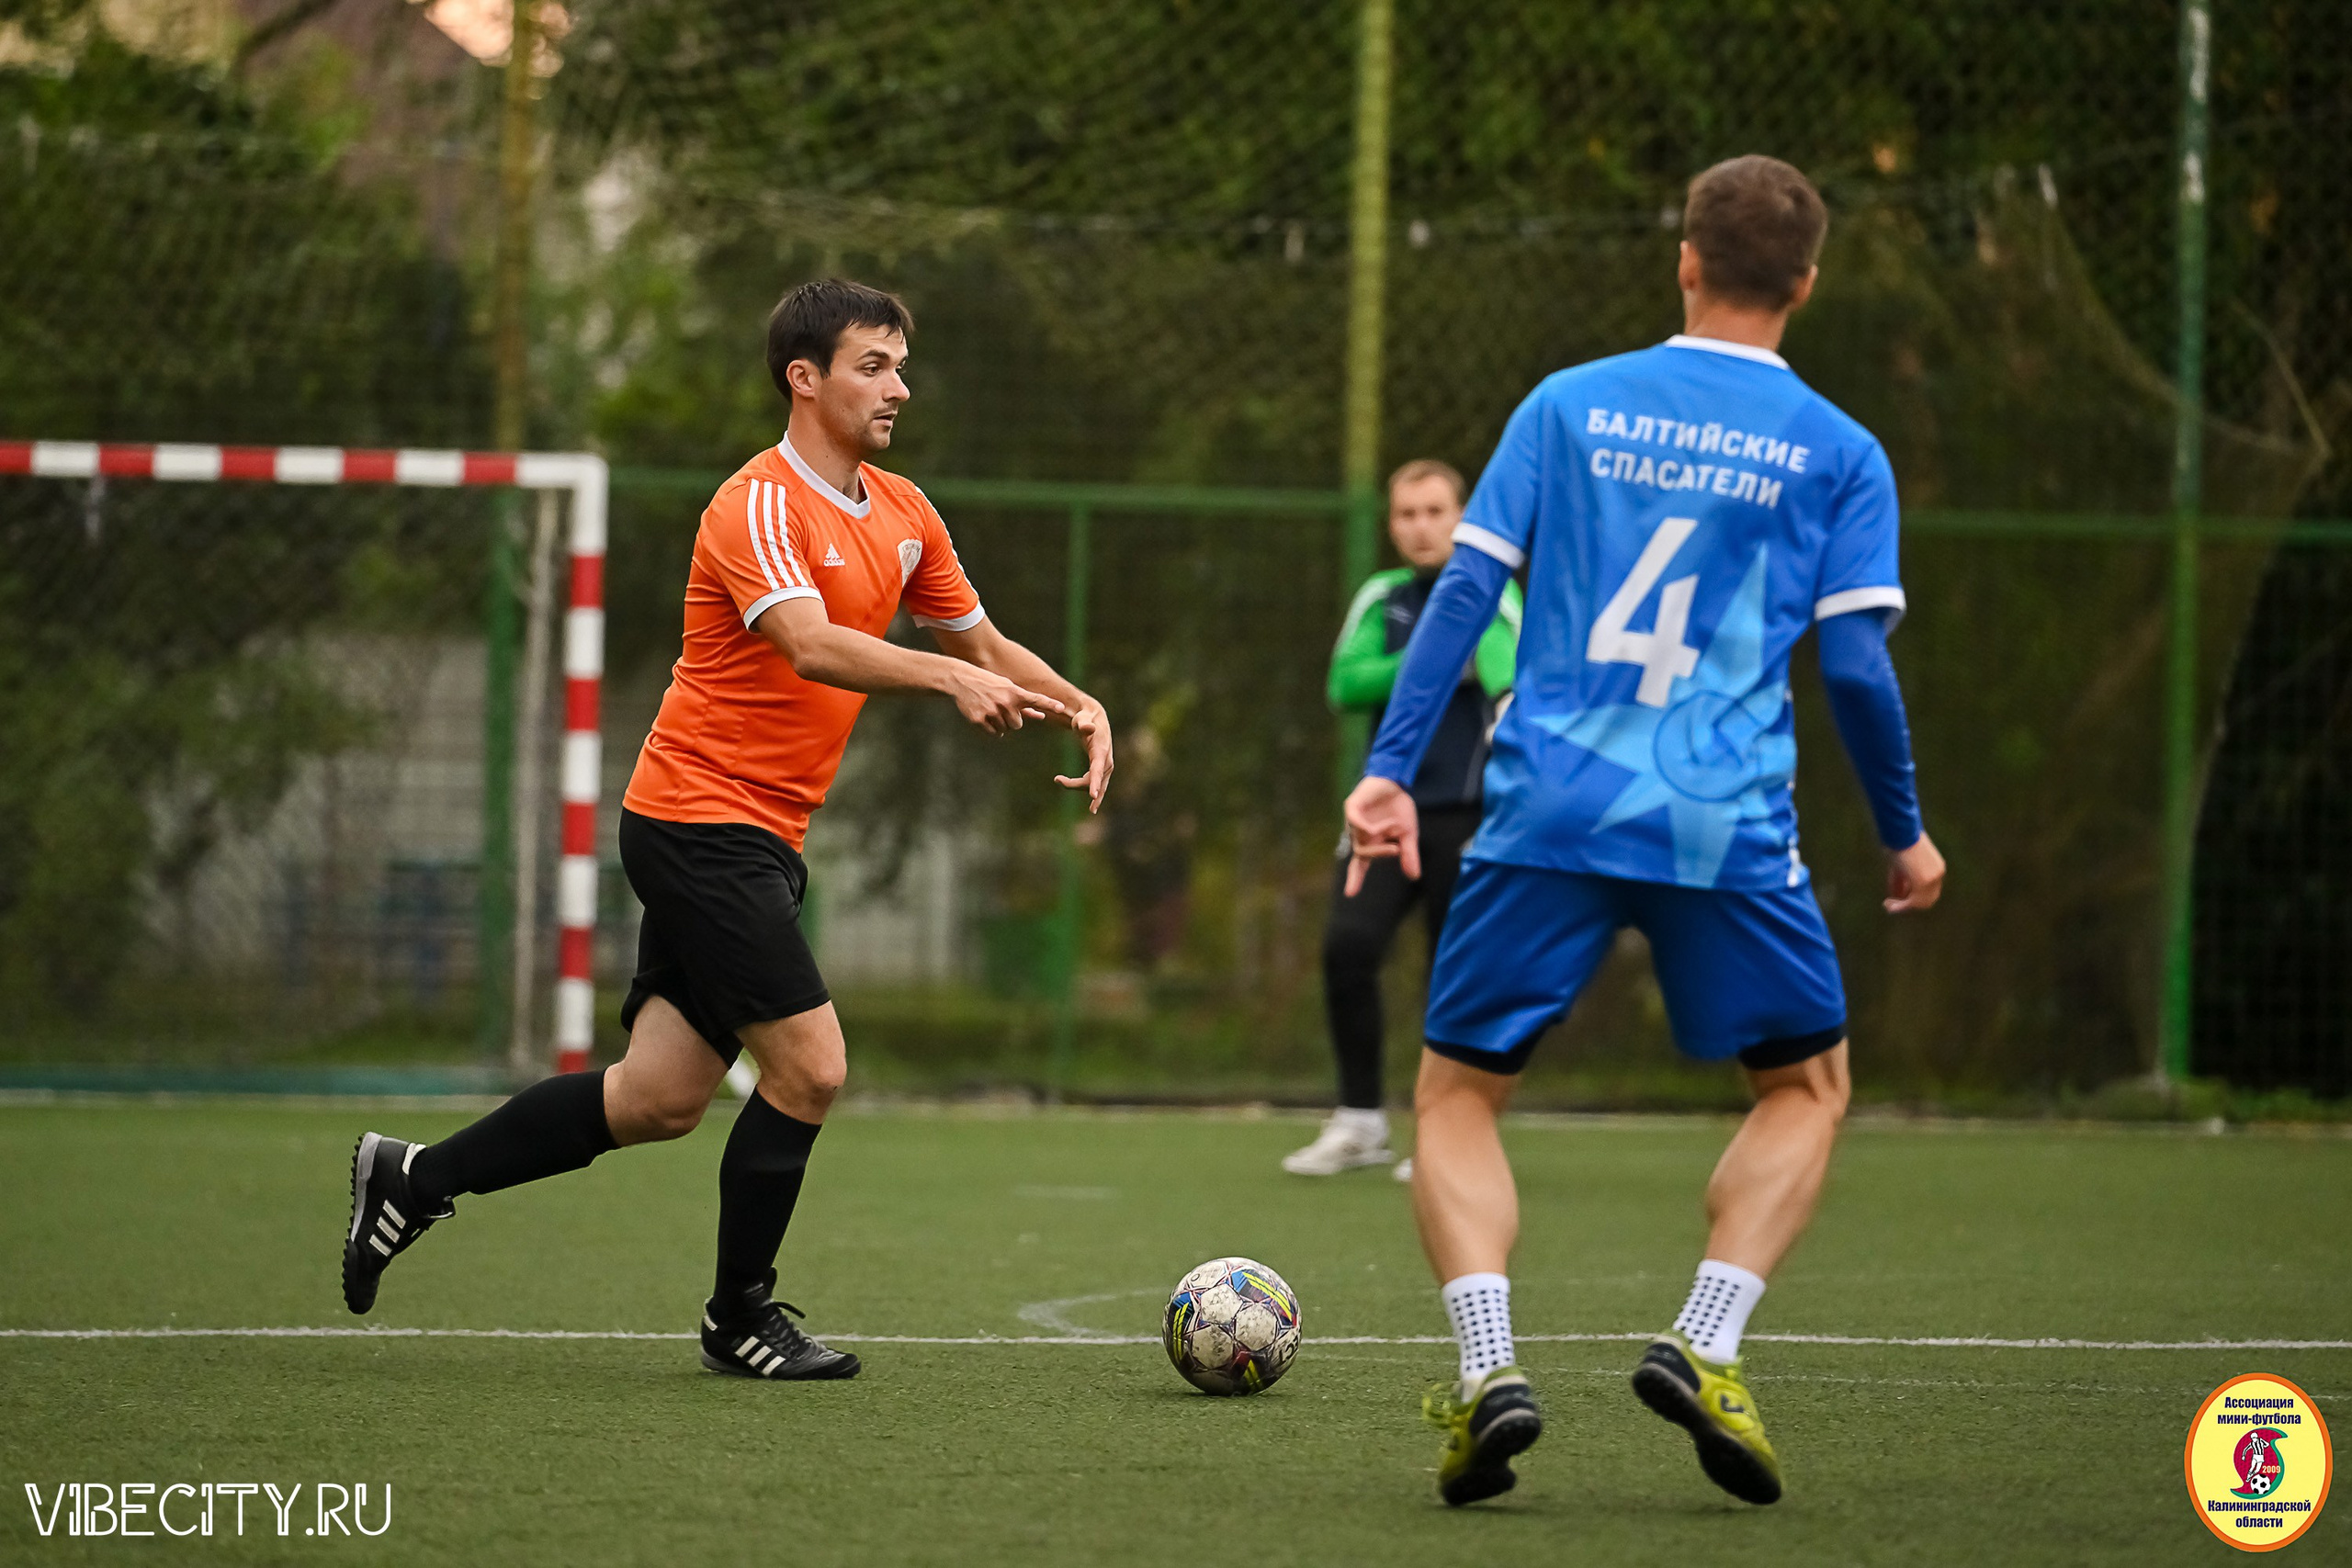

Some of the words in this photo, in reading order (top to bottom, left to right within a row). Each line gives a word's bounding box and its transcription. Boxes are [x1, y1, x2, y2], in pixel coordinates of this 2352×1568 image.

[1587, 409, 1810, 474] БАЛТИЙСКИЕ
[1590, 448, 1783, 508] СПАСАТЕЛИ
[823, 558, 845, 567] adidas
[1587, 517, 1700, 707] 4
